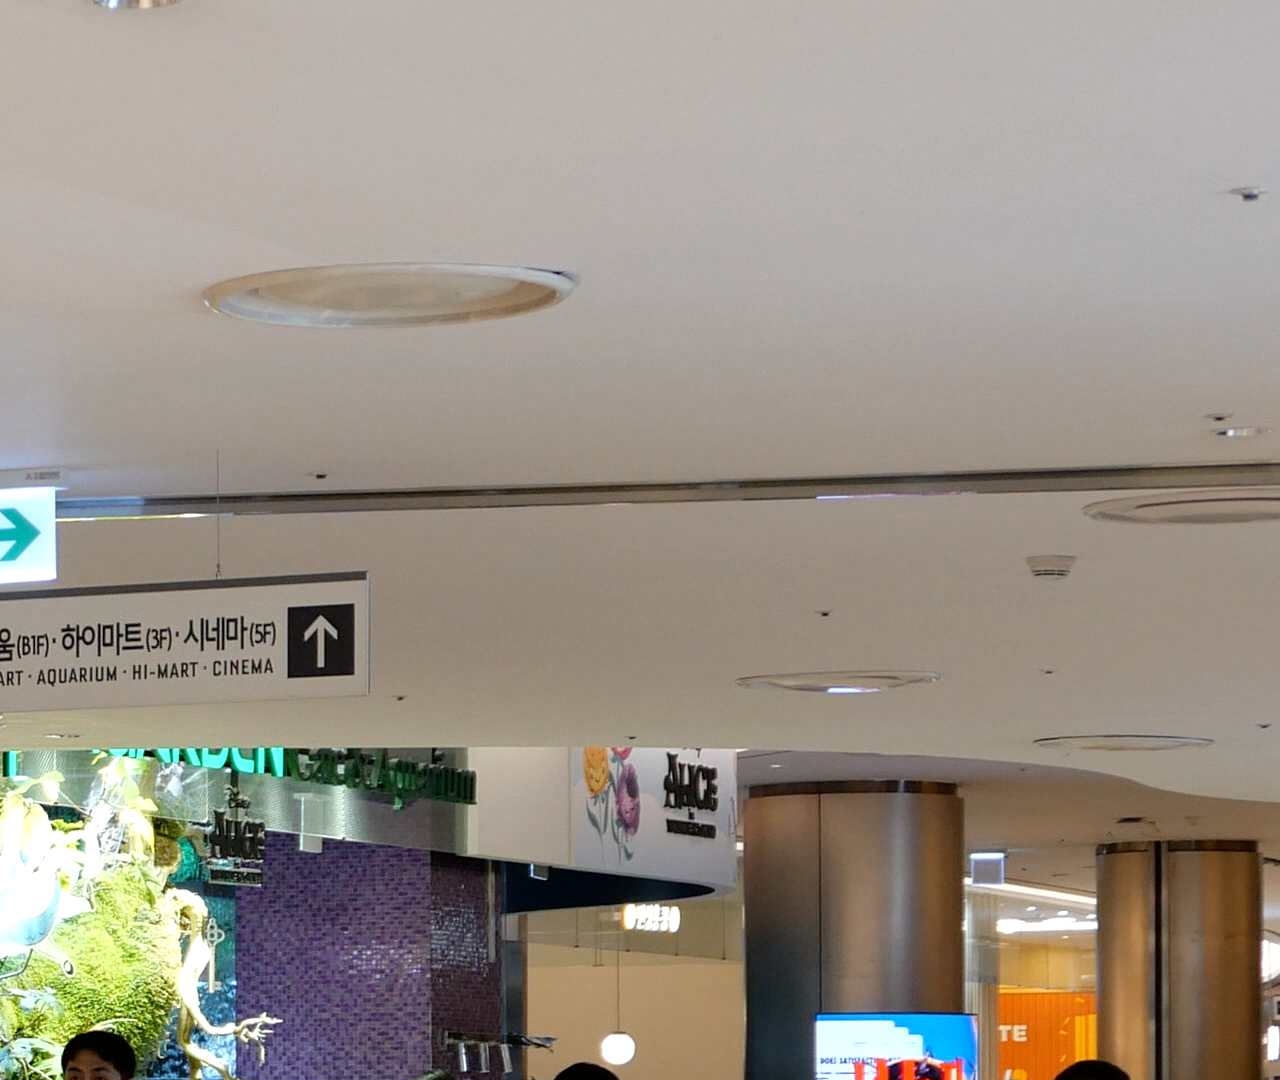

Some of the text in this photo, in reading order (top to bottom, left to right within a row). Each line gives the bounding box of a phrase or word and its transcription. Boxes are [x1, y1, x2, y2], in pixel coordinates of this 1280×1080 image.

[36, 665, 117, 687] AQUARIUM
[132, 661, 199, 681] HI-MART
[212, 657, 274, 677] CINEMA
